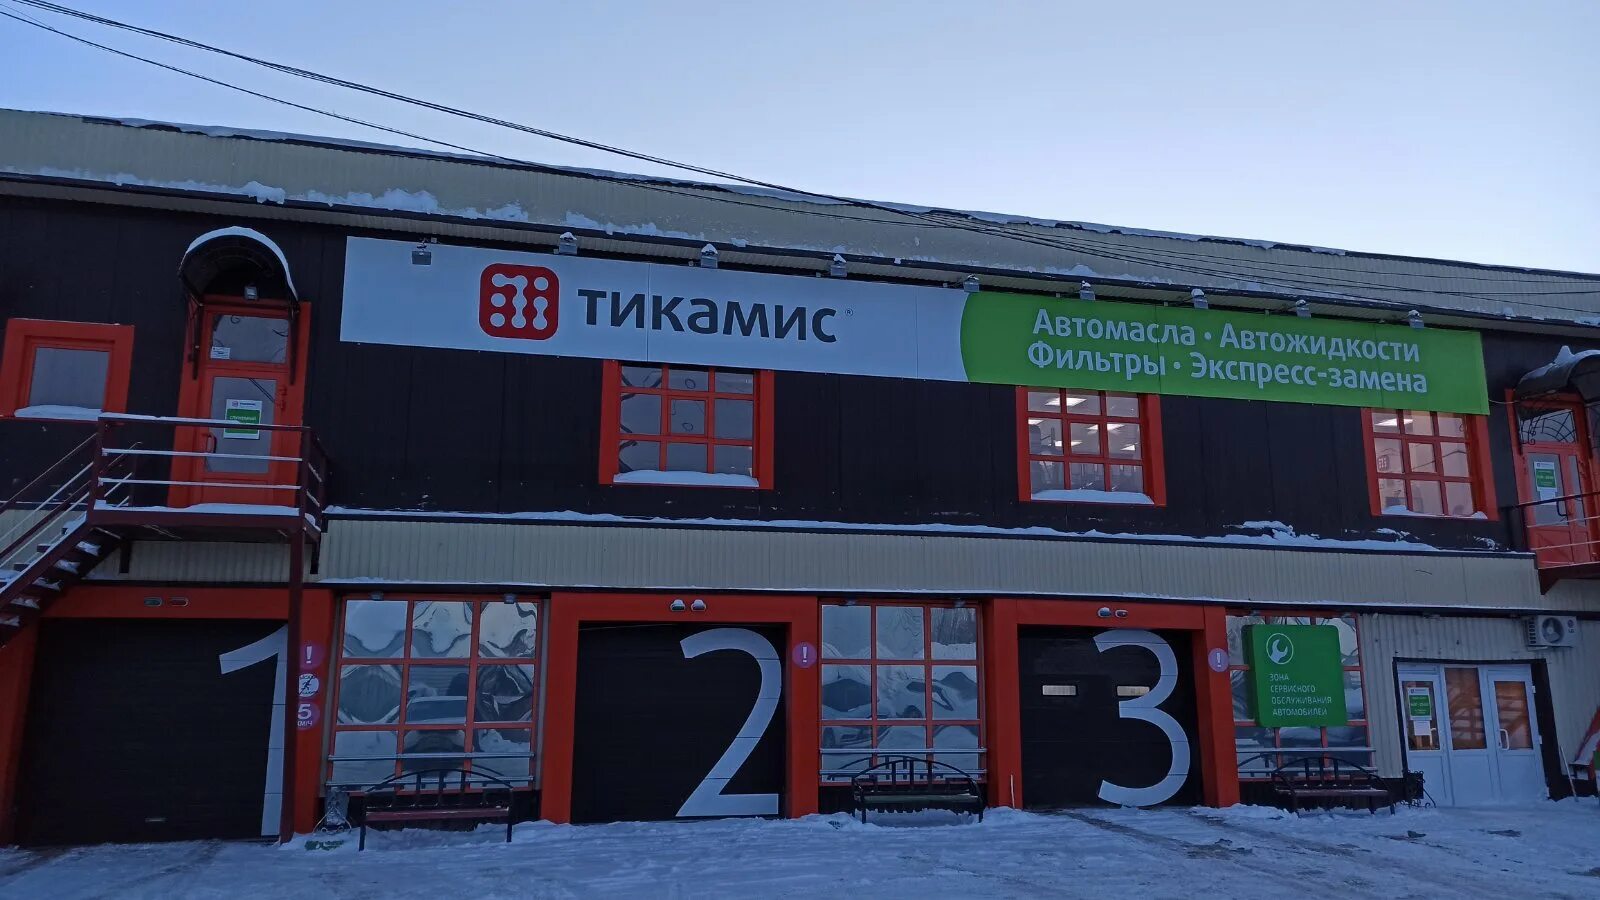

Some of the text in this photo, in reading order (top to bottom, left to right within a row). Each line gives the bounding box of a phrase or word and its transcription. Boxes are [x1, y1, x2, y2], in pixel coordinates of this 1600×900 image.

[1032, 308, 1421, 362] Автомасла Автожидкости
[1027, 340, 1428, 393] Фильтры Экспресс-замена
[1269, 673, 1290, 681] ЗОНА
[1270, 685, 1316, 693] СЕРВИСНОГО
[1271, 696, 1333, 705] ОБСЛУЖИВАНИЯ
[219, 624, 289, 836] 1
[297, 703, 312, 720] 5
[675, 627, 782, 817] 2
[1093, 628, 1191, 809] 3
